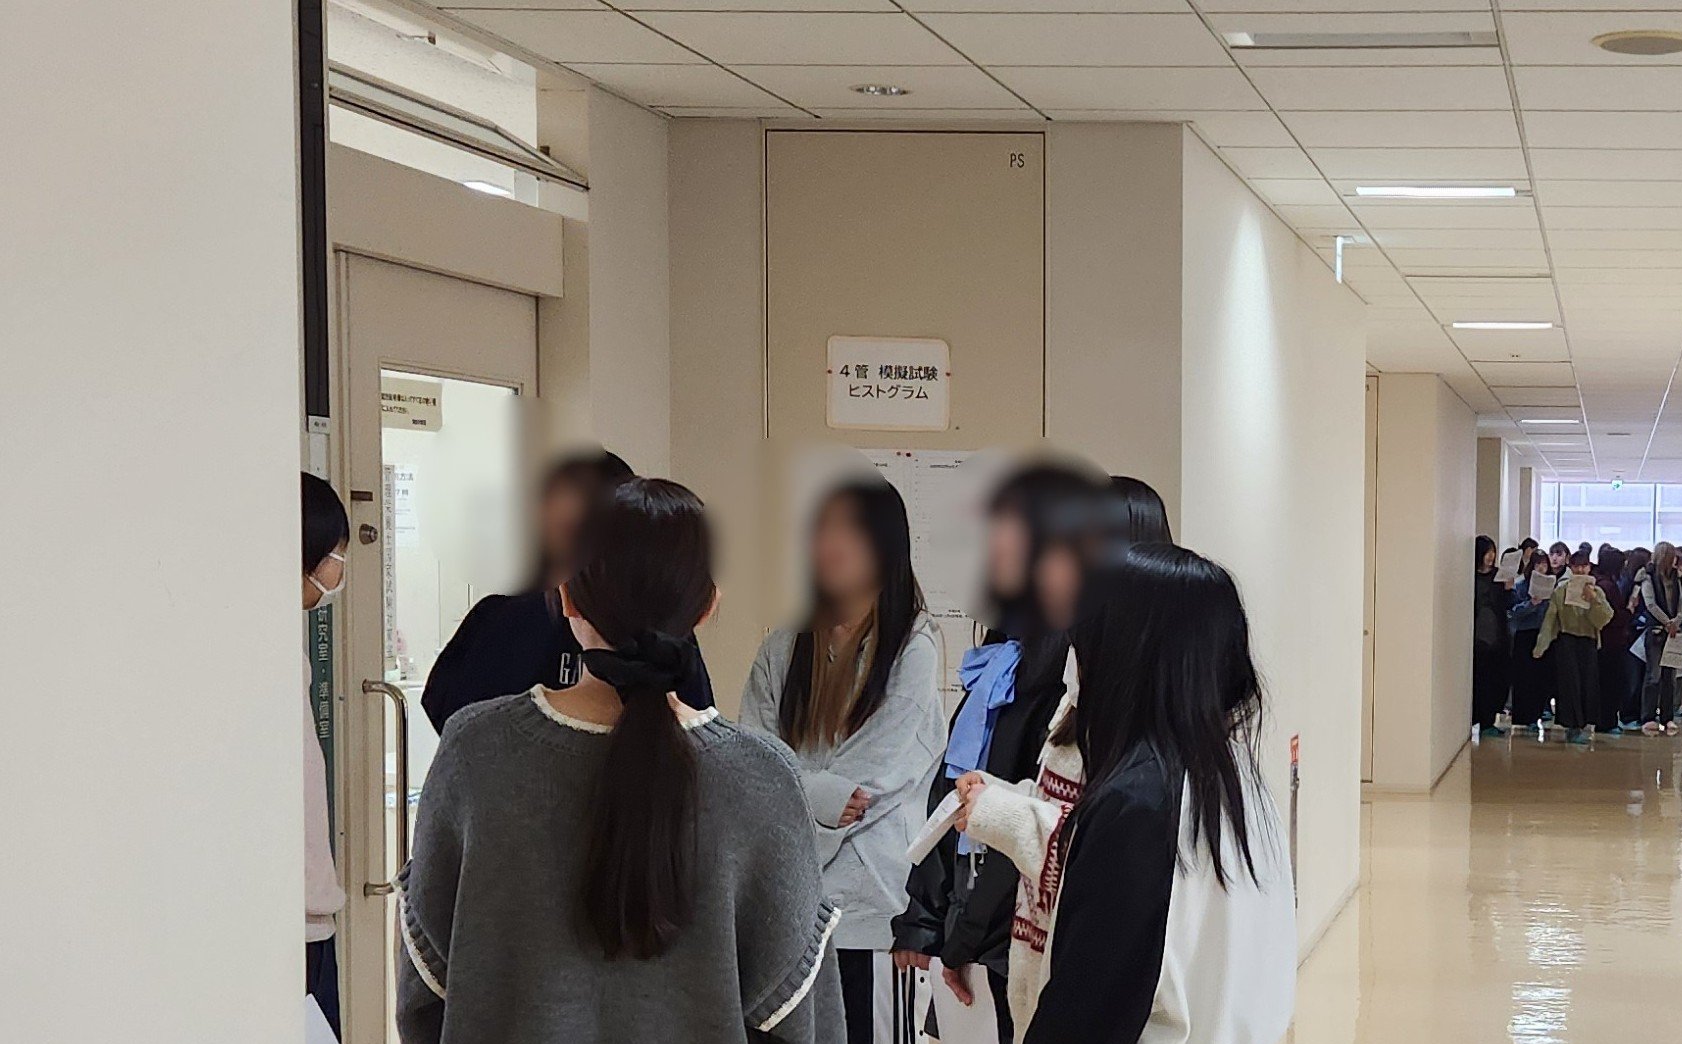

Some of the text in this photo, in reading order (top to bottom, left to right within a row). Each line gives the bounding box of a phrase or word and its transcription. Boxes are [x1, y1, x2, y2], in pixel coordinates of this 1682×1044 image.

[1010, 153, 1025, 168] PS
[878, 365, 938, 381] 模擬試験
[849, 384, 928, 399] ヒストグラム
